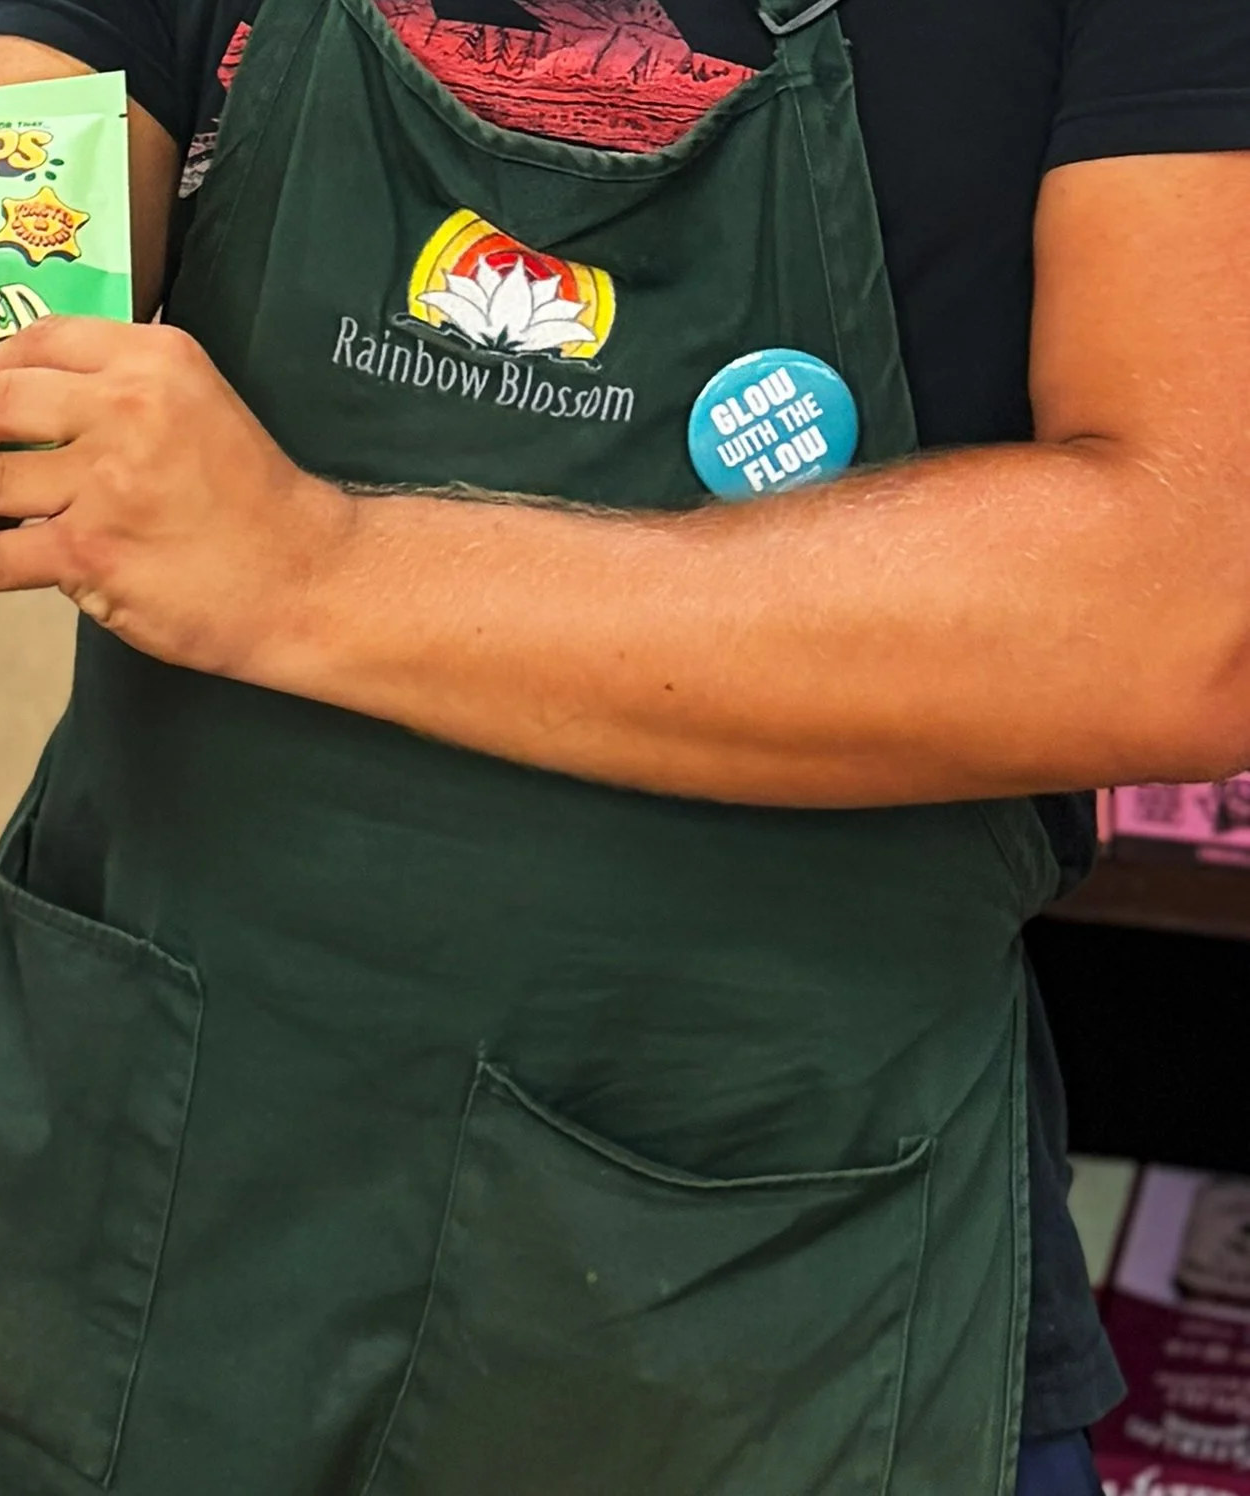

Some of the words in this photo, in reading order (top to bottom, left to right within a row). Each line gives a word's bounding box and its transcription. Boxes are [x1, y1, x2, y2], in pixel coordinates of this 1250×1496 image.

[332, 316, 491, 401] Rainbow
[499, 358, 636, 423] Blossom
[710, 366, 797, 436] GLOW
[716, 418, 779, 468] WITH
[774, 391, 824, 433] THE
[742, 425, 828, 492] FLOW
